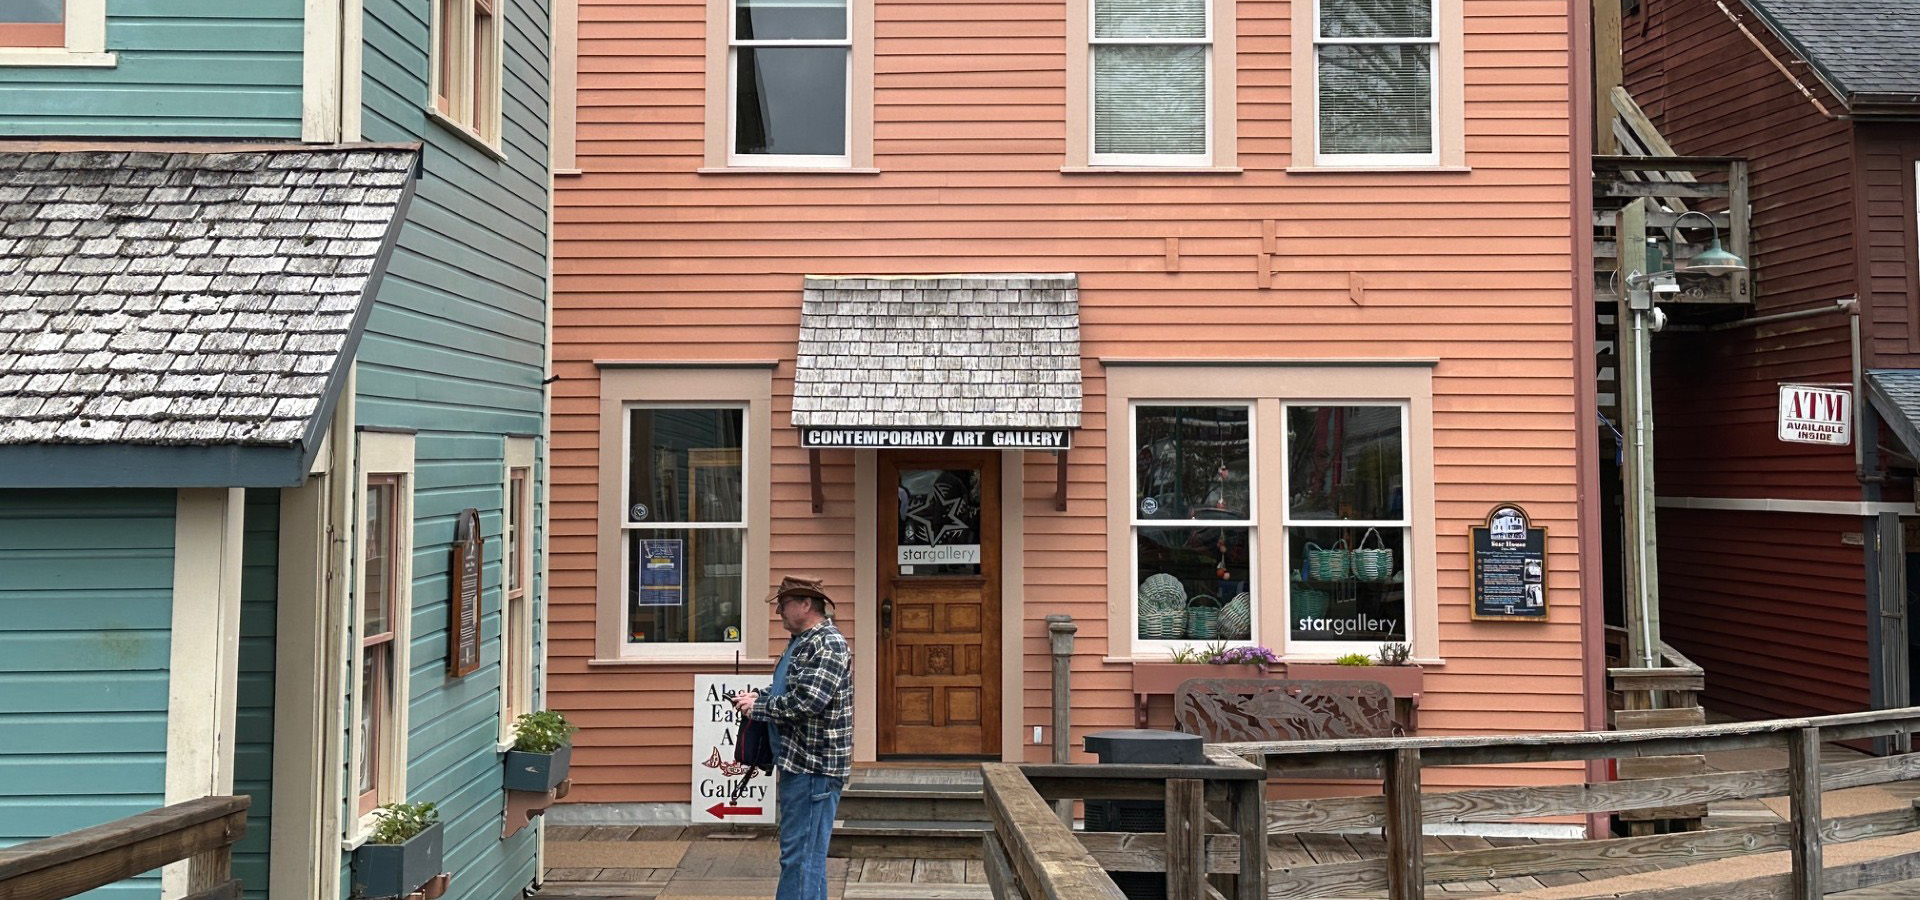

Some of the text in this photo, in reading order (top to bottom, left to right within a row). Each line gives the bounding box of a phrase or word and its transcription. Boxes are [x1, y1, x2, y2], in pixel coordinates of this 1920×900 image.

[1787, 391, 1843, 422] ATM
[1786, 422, 1844, 434] AVAILABLE
[1798, 431, 1832, 441] INSIDE
[808, 430, 1063, 447] CONTEMPORARY ART GALLERY
[903, 546, 975, 563] stargallery
[1299, 613, 1397, 636] stargallery
